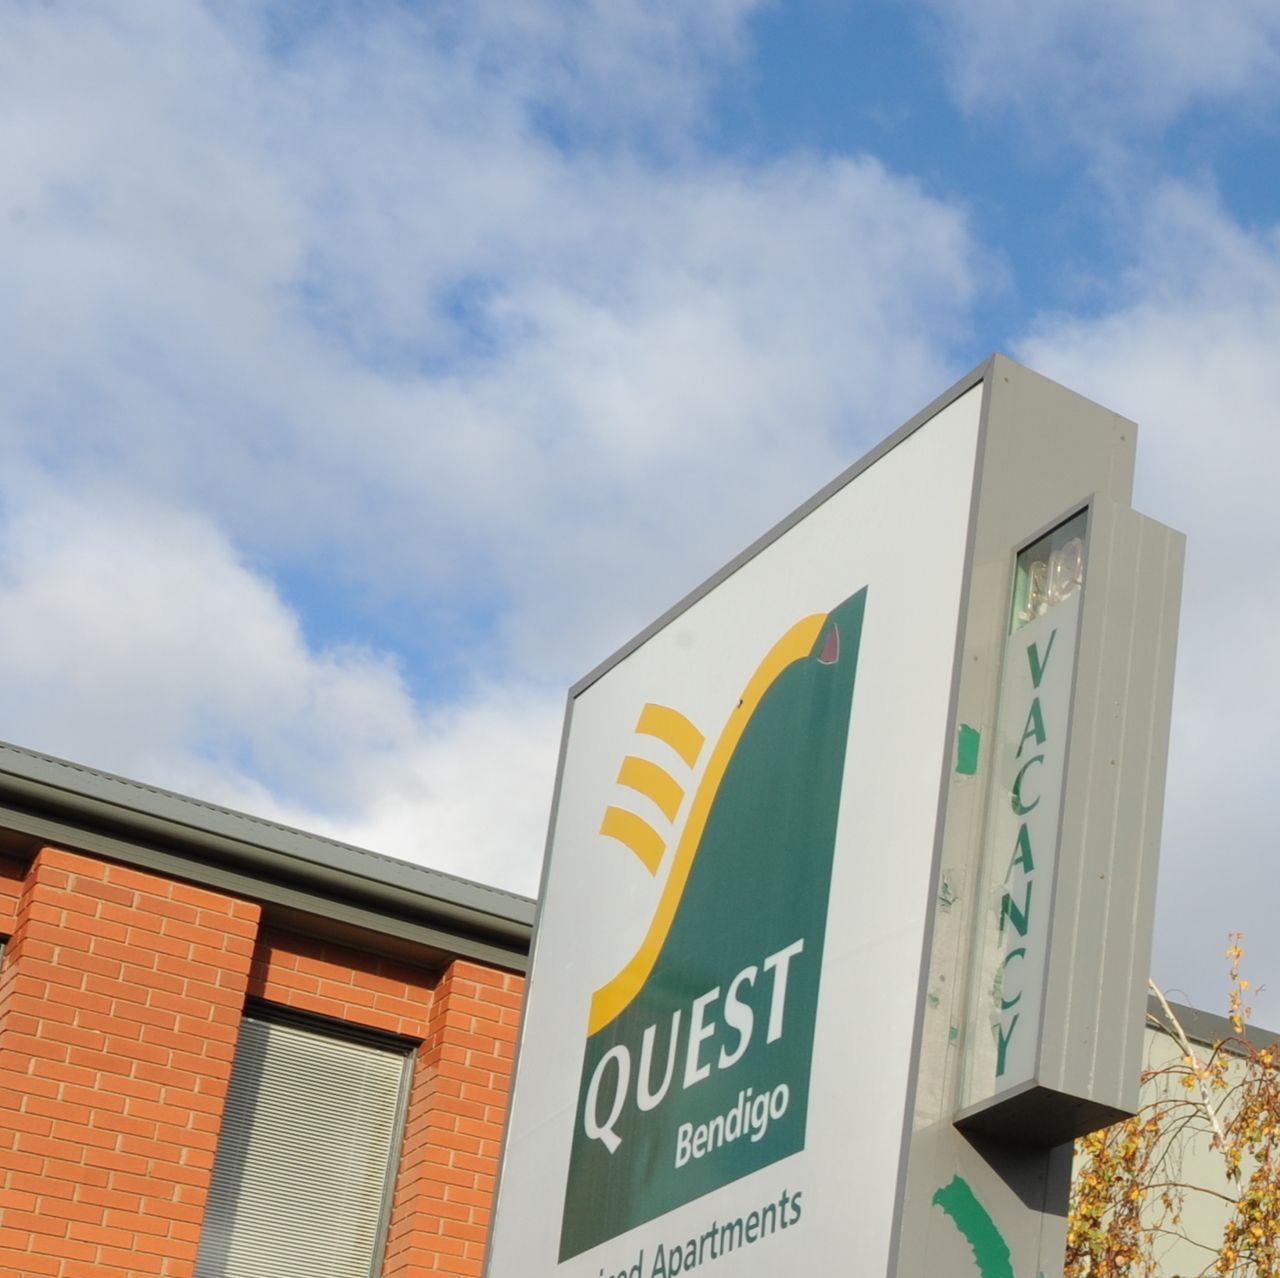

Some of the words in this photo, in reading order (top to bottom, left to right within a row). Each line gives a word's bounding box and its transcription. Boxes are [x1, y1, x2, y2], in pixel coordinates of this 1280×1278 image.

[992, 628, 1057, 1078] VACANCY
[583, 937, 805, 1154] QUEST
[674, 1083, 790, 1169] Bendigo
